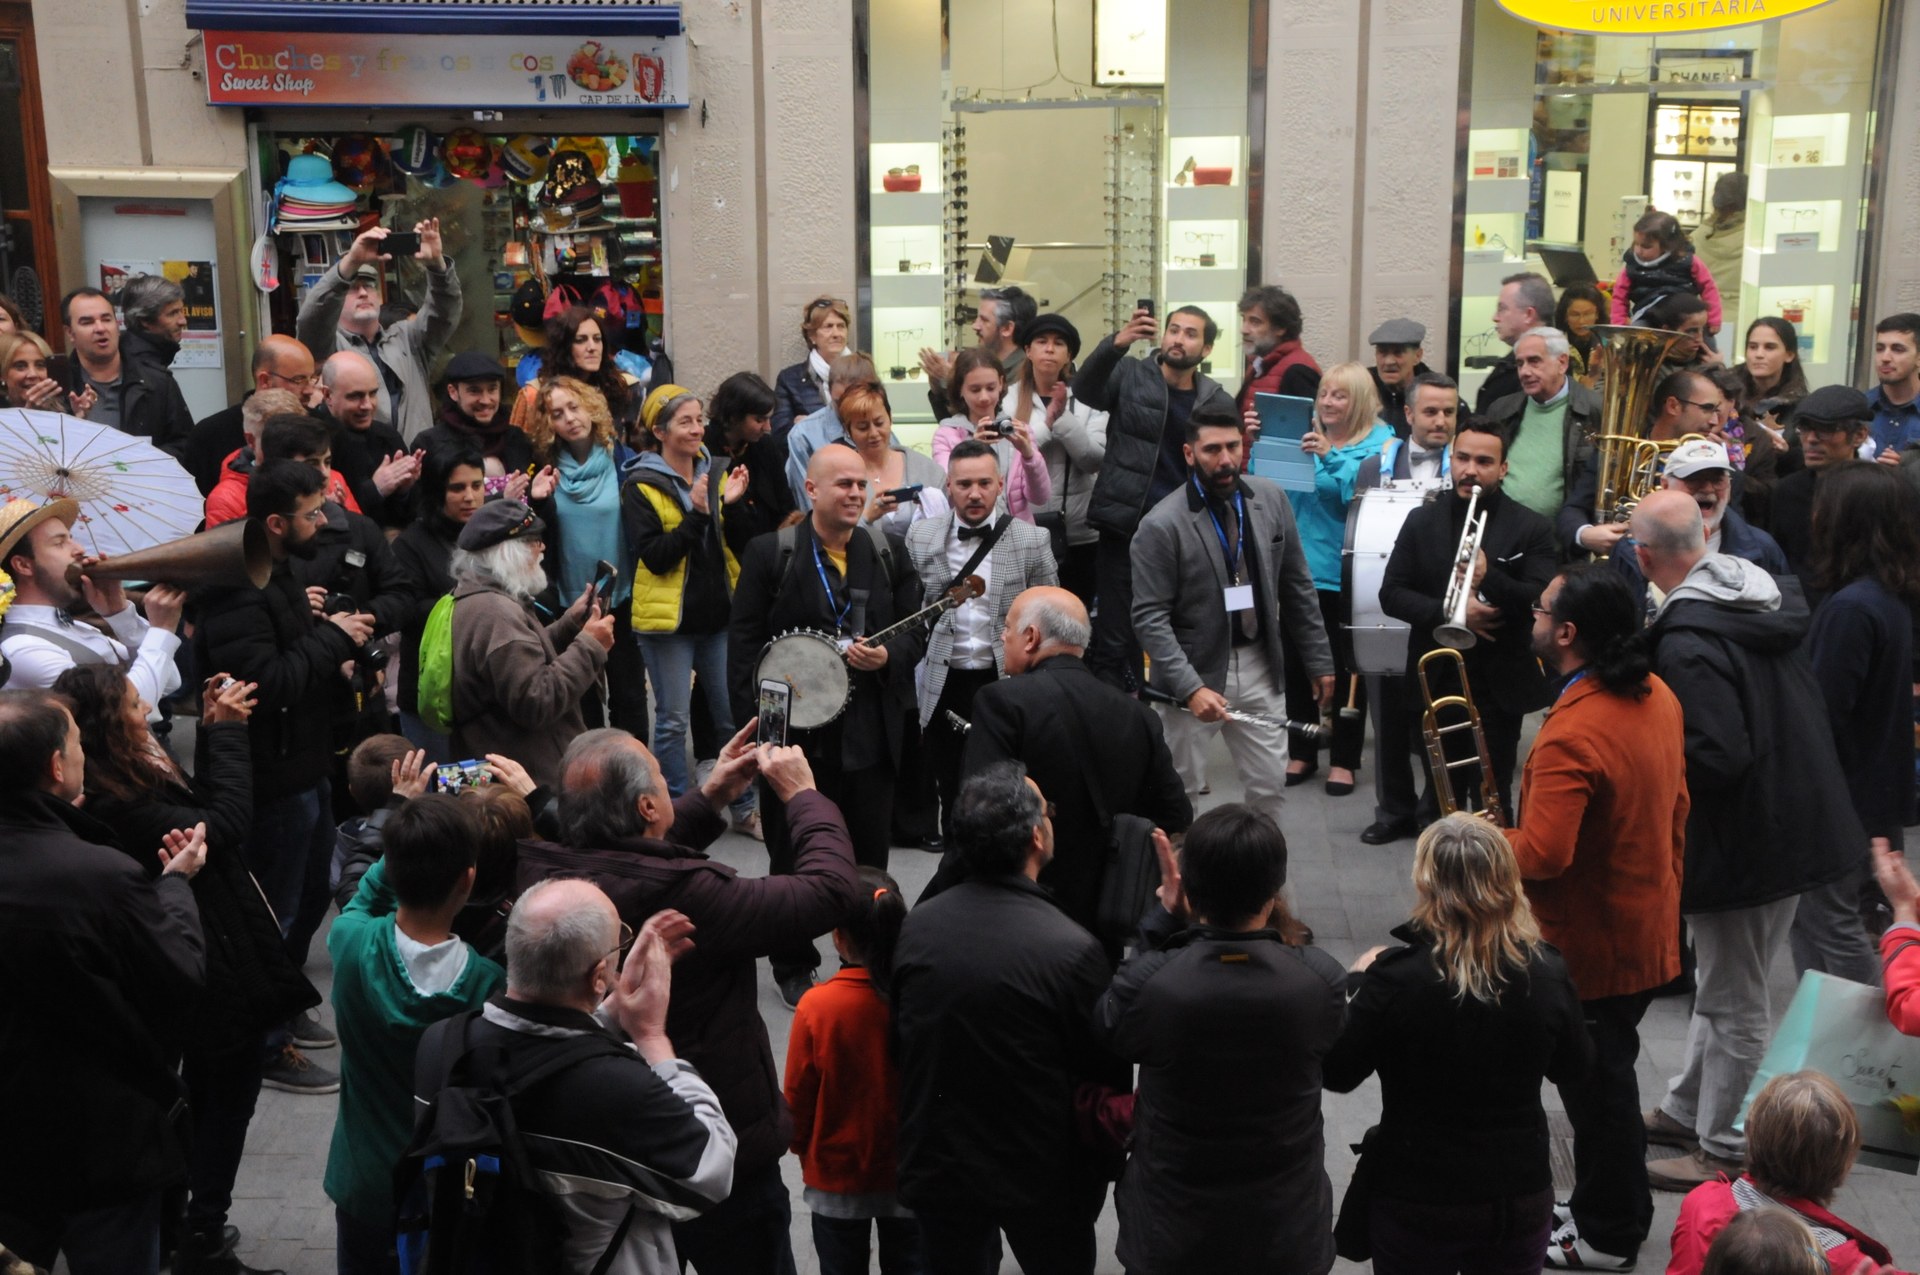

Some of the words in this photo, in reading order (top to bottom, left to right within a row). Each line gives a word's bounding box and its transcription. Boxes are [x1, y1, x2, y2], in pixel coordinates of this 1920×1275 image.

[1592, 0, 1766, 24] UNIVERSITARIA
[215, 44, 342, 71] Chuches
[350, 55, 367, 78] y
[220, 73, 271, 92] Sweet
[273, 73, 316, 97] Shop
[1670, 72, 1730, 81] CHANE
[580, 94, 603, 105] CAP
[606, 94, 622, 105] DE
[625, 94, 641, 105] LA
[191, 306, 214, 317] AVISO
